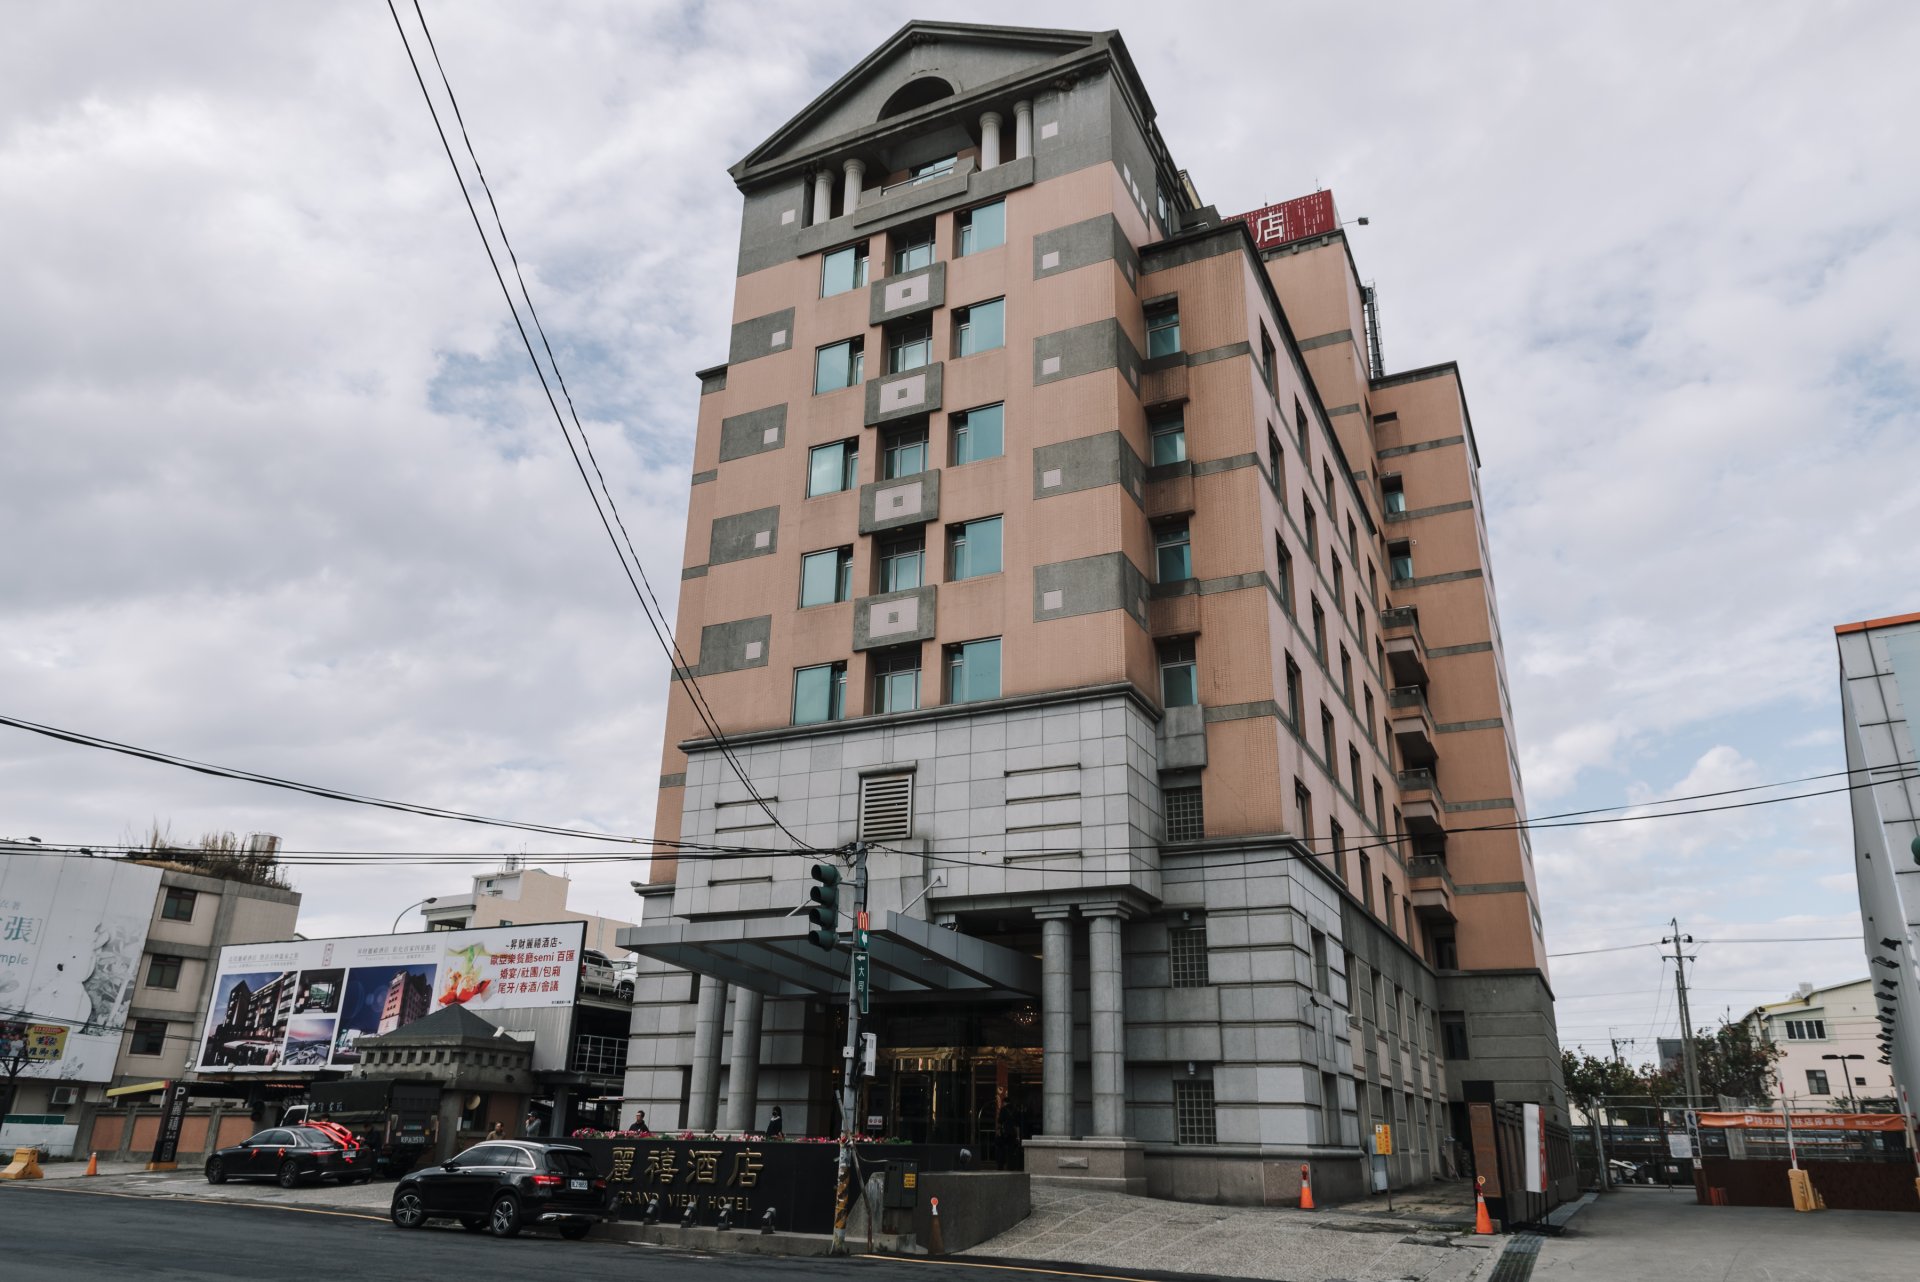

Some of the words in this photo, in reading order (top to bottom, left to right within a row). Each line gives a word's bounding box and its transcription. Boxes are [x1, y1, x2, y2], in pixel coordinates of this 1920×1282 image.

[1255, 212, 1285, 243] 店
[557, 950, 576, 962] 百匯
[497, 981, 559, 994] 尾牙/春酒/會議
[174, 1087, 186, 1100] P
[605, 1146, 764, 1188] 麗禧酒店
[708, 1196, 752, 1211] HOTEL
